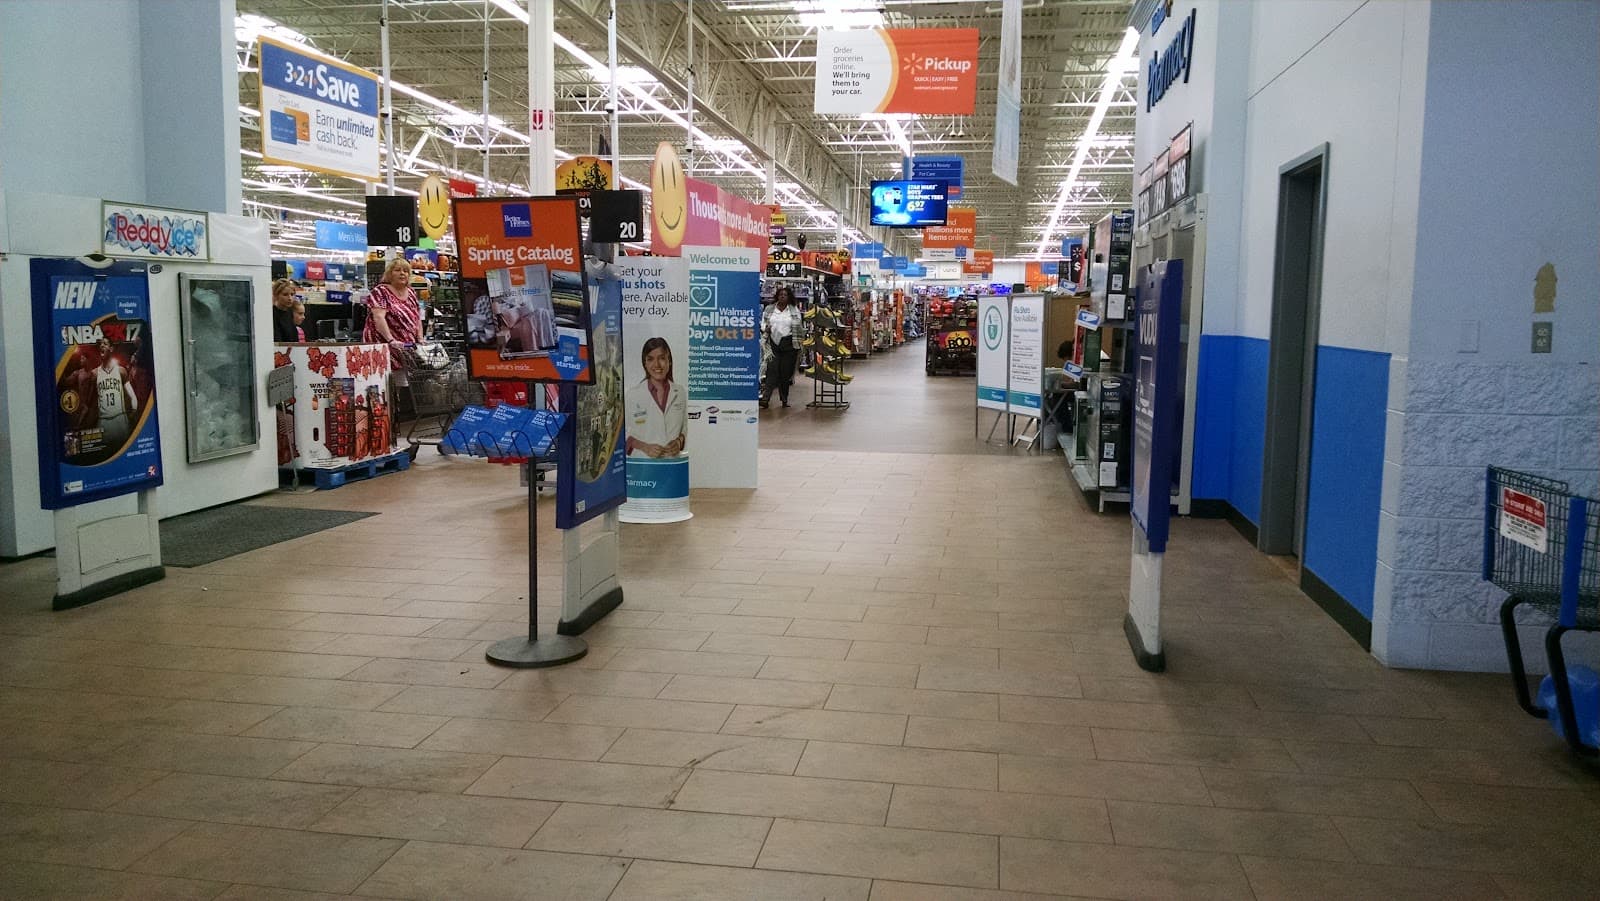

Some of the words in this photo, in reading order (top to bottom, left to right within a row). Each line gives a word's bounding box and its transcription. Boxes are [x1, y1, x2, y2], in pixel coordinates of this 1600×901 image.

[833, 55, 864, 63] groceries
[925, 57, 971, 73] Pickup
[851, 71, 871, 80] bring
[316, 64, 361, 107] Save
[316, 109, 335, 128] Earn
[336, 116, 375, 138] unlimited
[316, 129, 336, 145] cash
[116, 215, 172, 251] Reddy
[396, 226, 411, 242] 18
[620, 221, 637, 239] 20
[463, 235, 490, 246] new!
[468, 246, 515, 265] Spring
[517, 243, 574, 265] Catalog
[690, 253, 736, 266] Welcome
[739, 255, 750, 265] to
[638, 268, 662, 279] your
[635, 279, 666, 290] shots
[53, 281, 98, 310] NEW
[624, 293, 642, 302] ere.
[645, 291, 688, 303] Available
[624, 306, 645, 317] very
[648, 304, 670, 317] day.
[719, 308, 755, 316] Walmart
[689, 311, 755, 328] Wellness
[68, 325, 104, 345] NBA
[688, 327, 714, 342] Day:
[715, 328, 738, 340] Oct
[106, 393, 116, 407] 13
